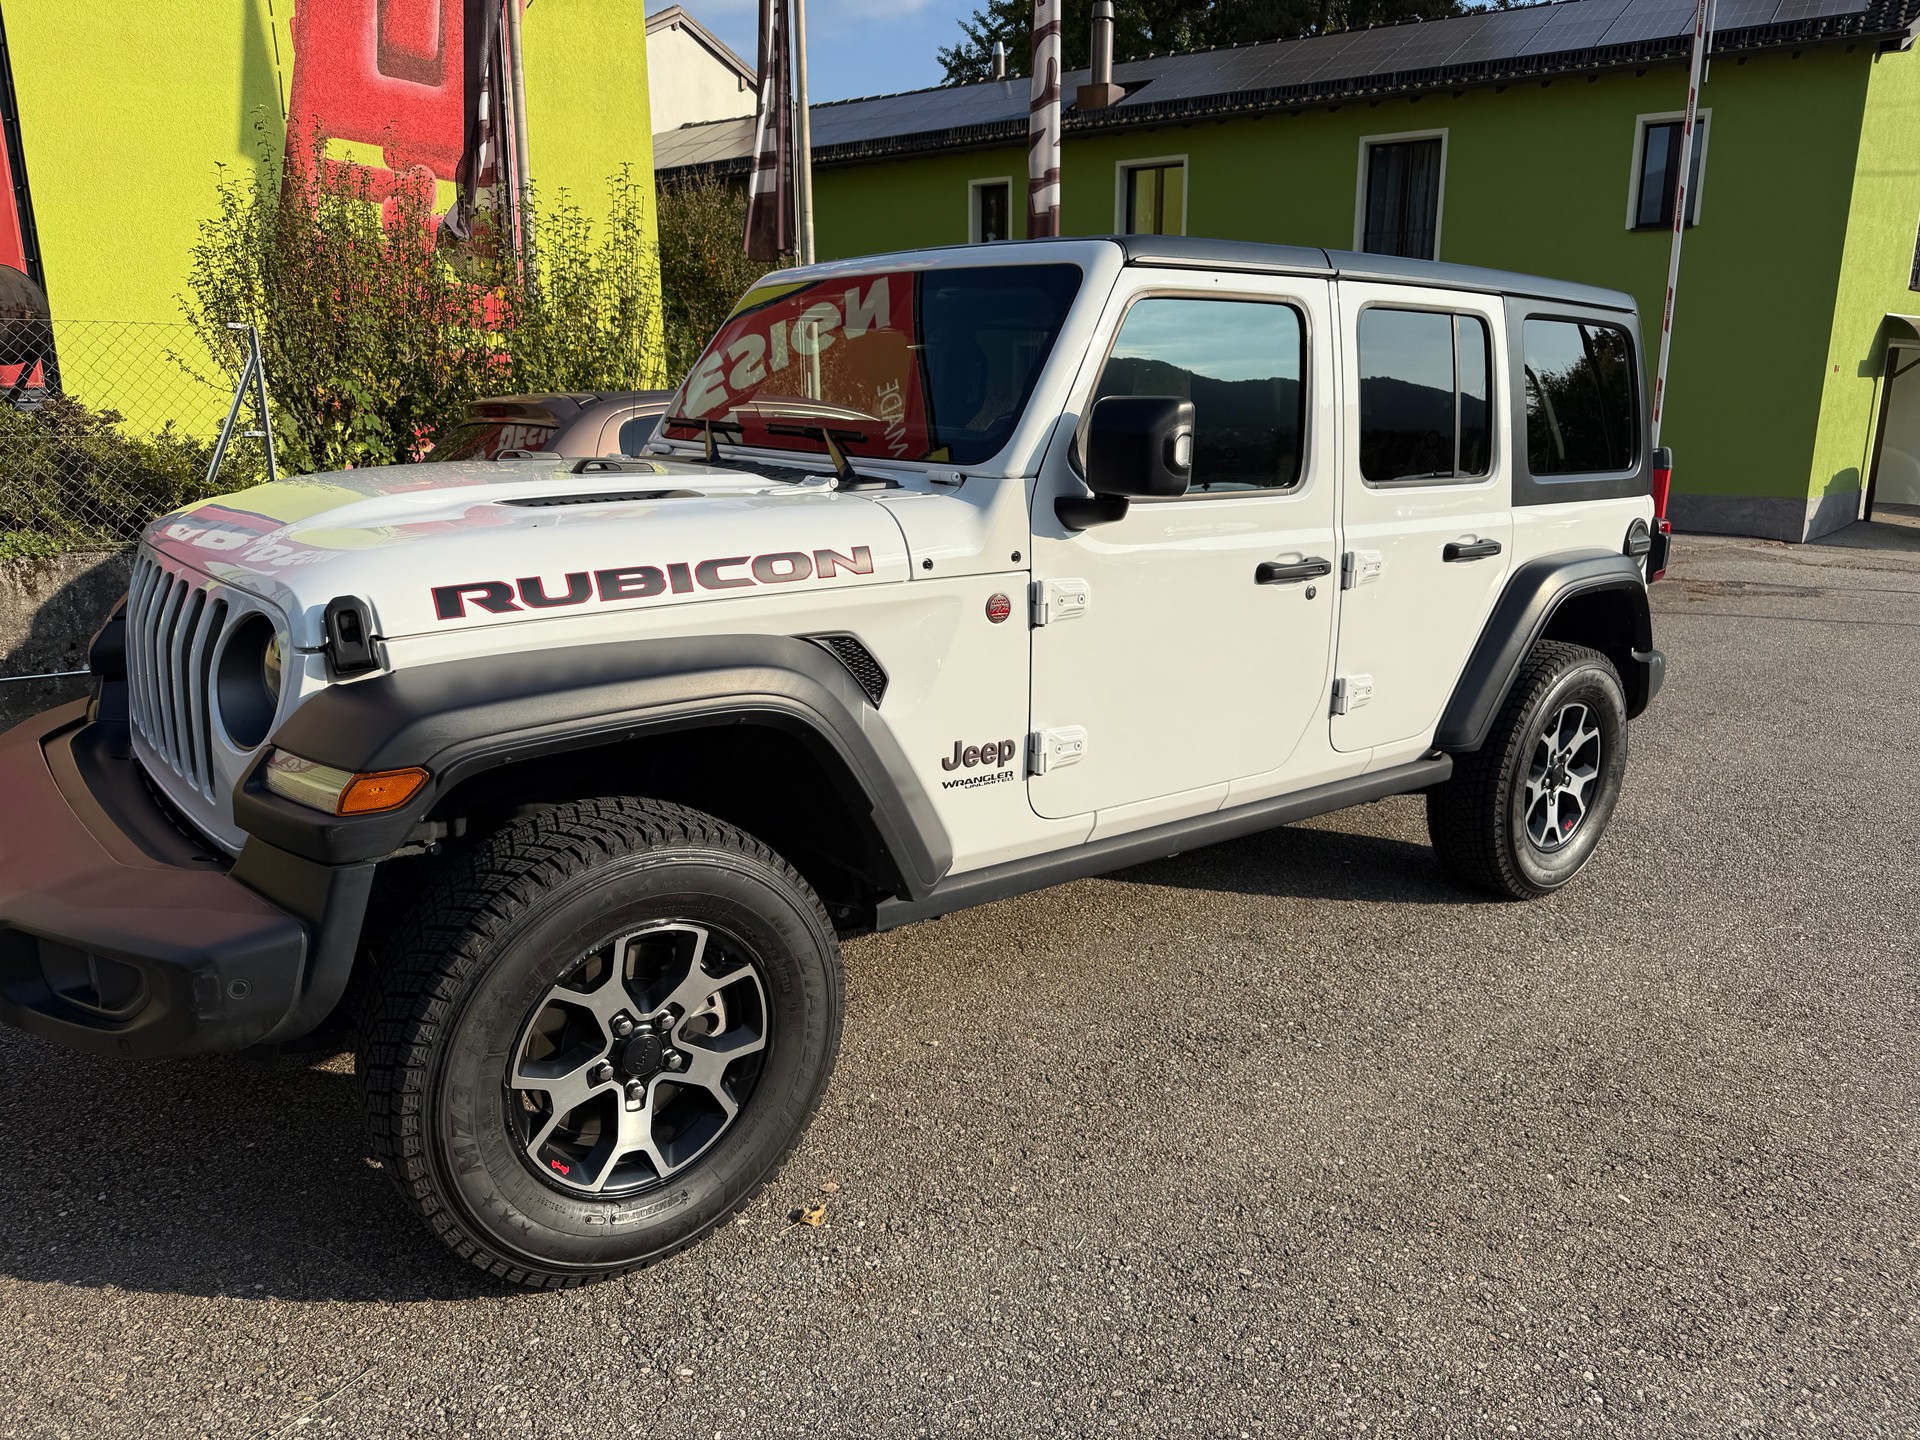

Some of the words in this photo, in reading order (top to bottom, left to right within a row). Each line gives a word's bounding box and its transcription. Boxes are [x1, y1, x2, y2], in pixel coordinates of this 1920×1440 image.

[430, 546, 874, 620] RUBICON
[941, 739, 1016, 771] Jeep
[941, 770, 1014, 789] WRANGLER
[964, 777, 1014, 789] UNLIMITED
